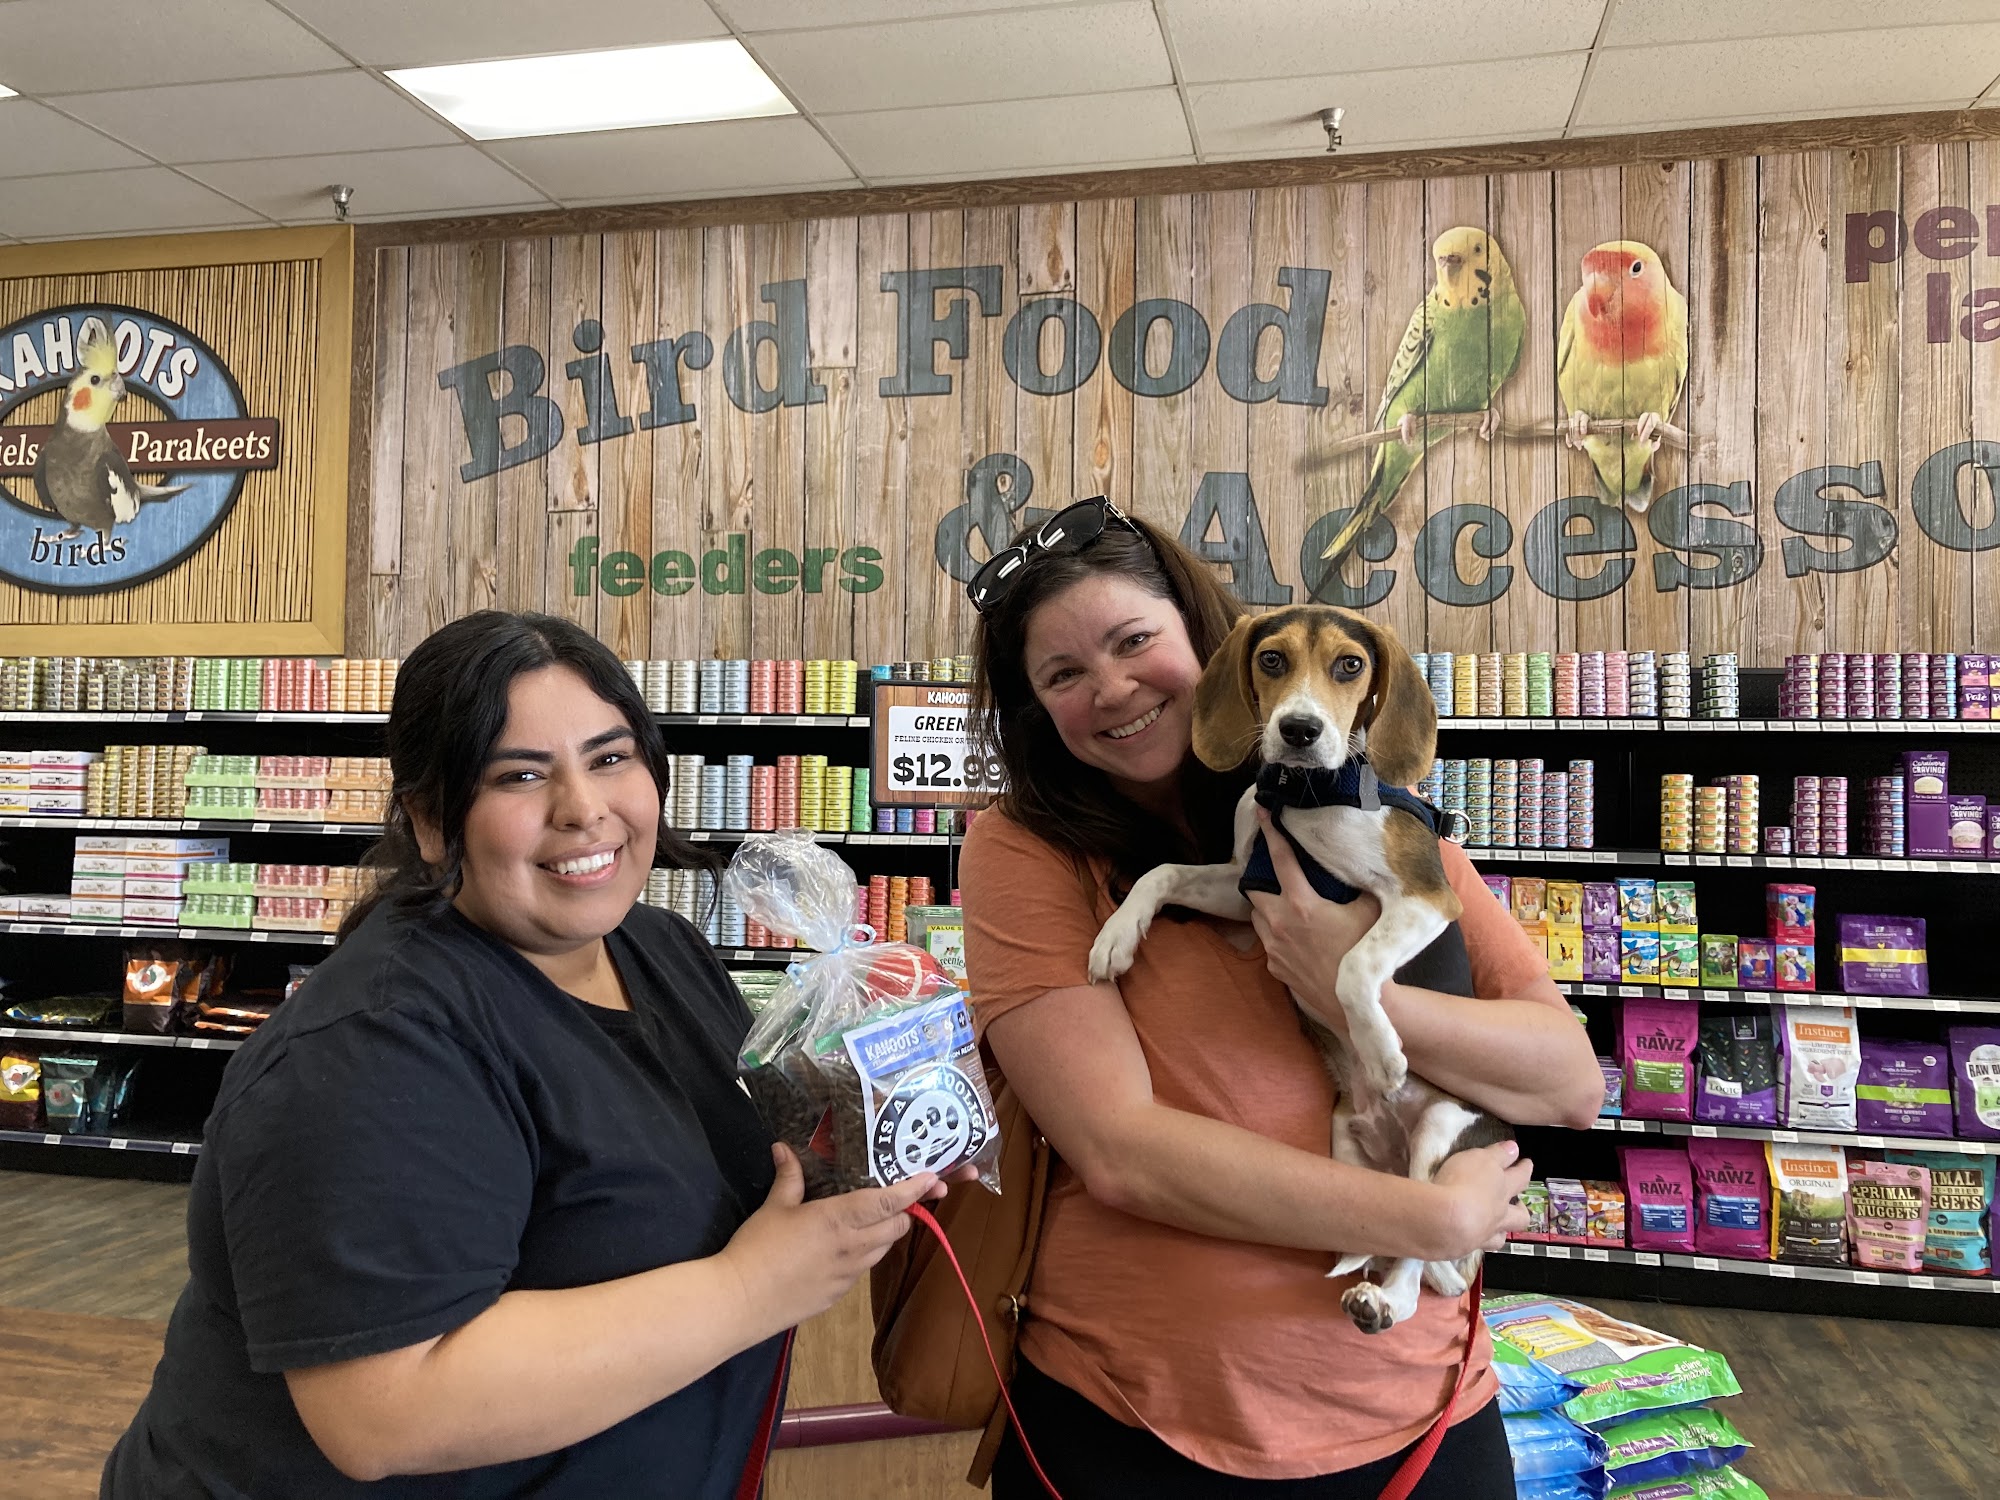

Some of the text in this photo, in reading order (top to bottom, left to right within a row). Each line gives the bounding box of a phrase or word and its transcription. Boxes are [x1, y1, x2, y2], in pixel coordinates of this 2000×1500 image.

[1927, 272, 2000, 343] la
[438, 265, 1331, 483] Bird Food
[128, 428, 271, 464] Parakeets
[935, 452, 1061, 586] &
[30, 527, 127, 567] birds
[569, 534, 884, 597] feeders
[894, 735, 921, 743] FELINE
[893, 752, 1002, 788] $12.99
[1912, 766, 1946, 774] CRAVINGS
[939, 956, 965, 968] reenie
[1799, 1025, 1845, 1038] Instinct
[865, 1029, 920, 1061] KAHOOTS
[1636, 1035, 1686, 1051] RAWZ
[1969, 1064, 1989, 1078] RAW
[1710, 1084, 1740, 1095] LOGIC
[878, 1120, 895, 1144] IS
[893, 1099, 906, 1115] A
[1785, 1160, 1832, 1174] Instinct
[1705, 1170, 1755, 1185] RAWZ
[1789, 1179, 1834, 1188] ORIGINAL
[1640, 1182, 1682, 1195] RAWZ
[1859, 1186, 1916, 1200] PRIMAL
[1857, 1205, 1920, 1219] NUGGETS
